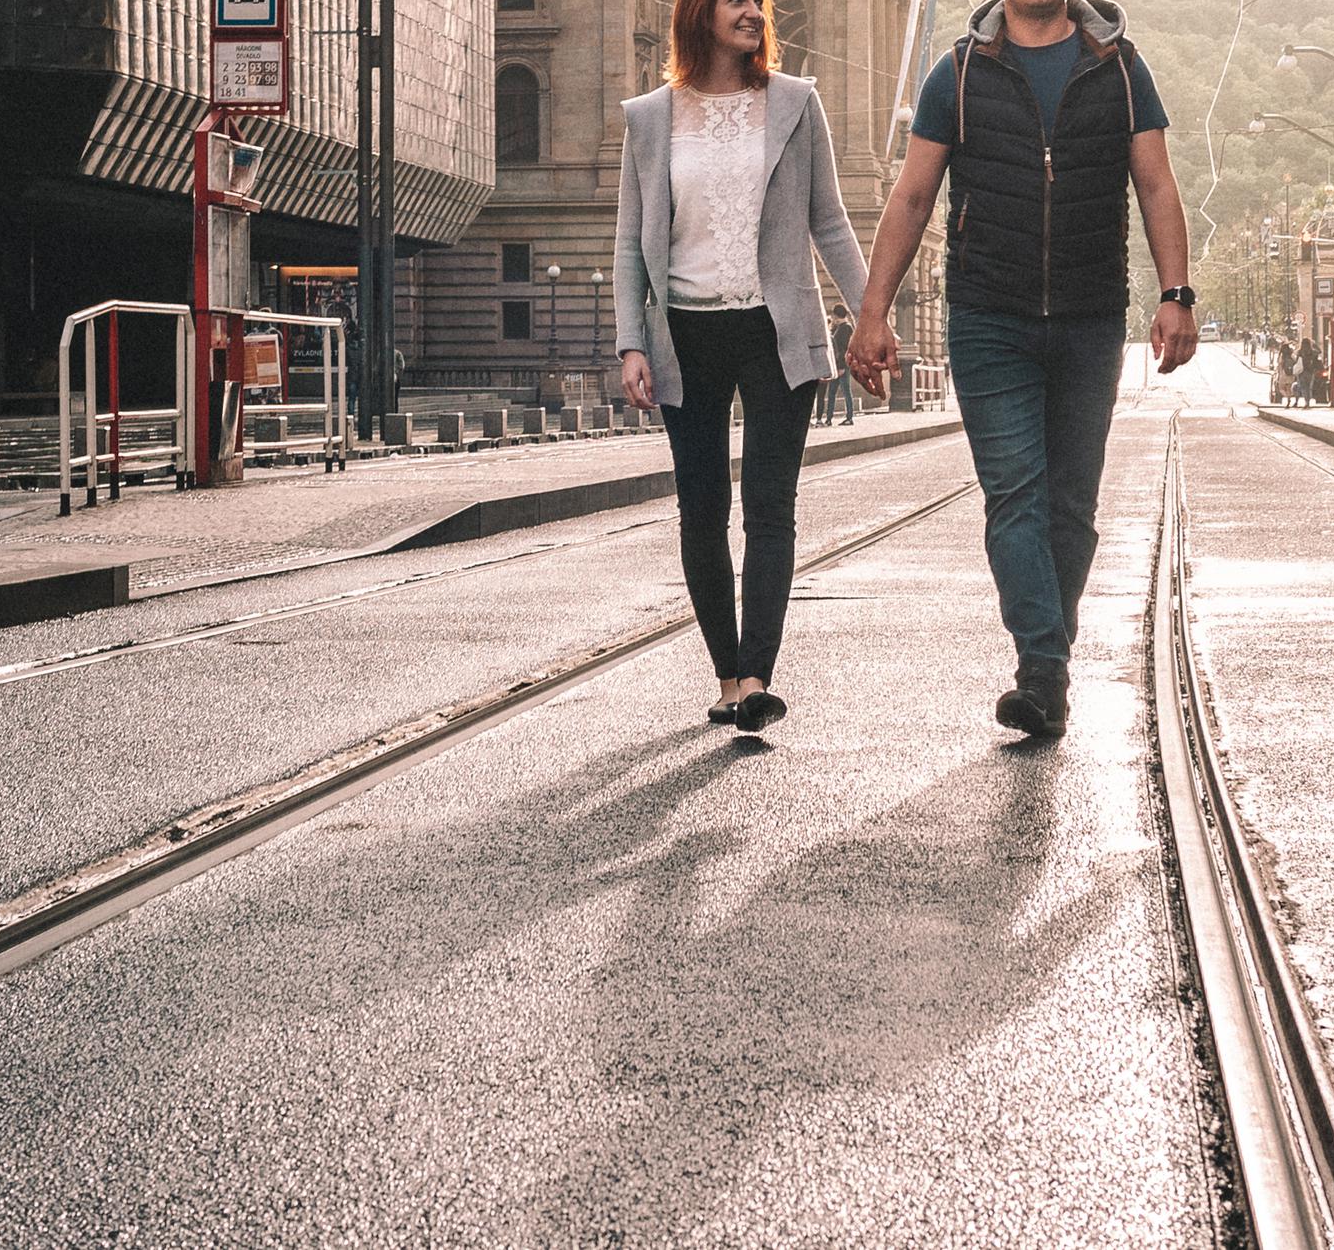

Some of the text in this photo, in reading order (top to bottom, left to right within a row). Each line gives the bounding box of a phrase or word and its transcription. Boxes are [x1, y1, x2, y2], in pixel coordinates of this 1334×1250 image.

[223, 62, 277, 73] 2 22 93 98
[223, 75, 277, 85] 9 23 97 99
[220, 87, 246, 97] 18 41
